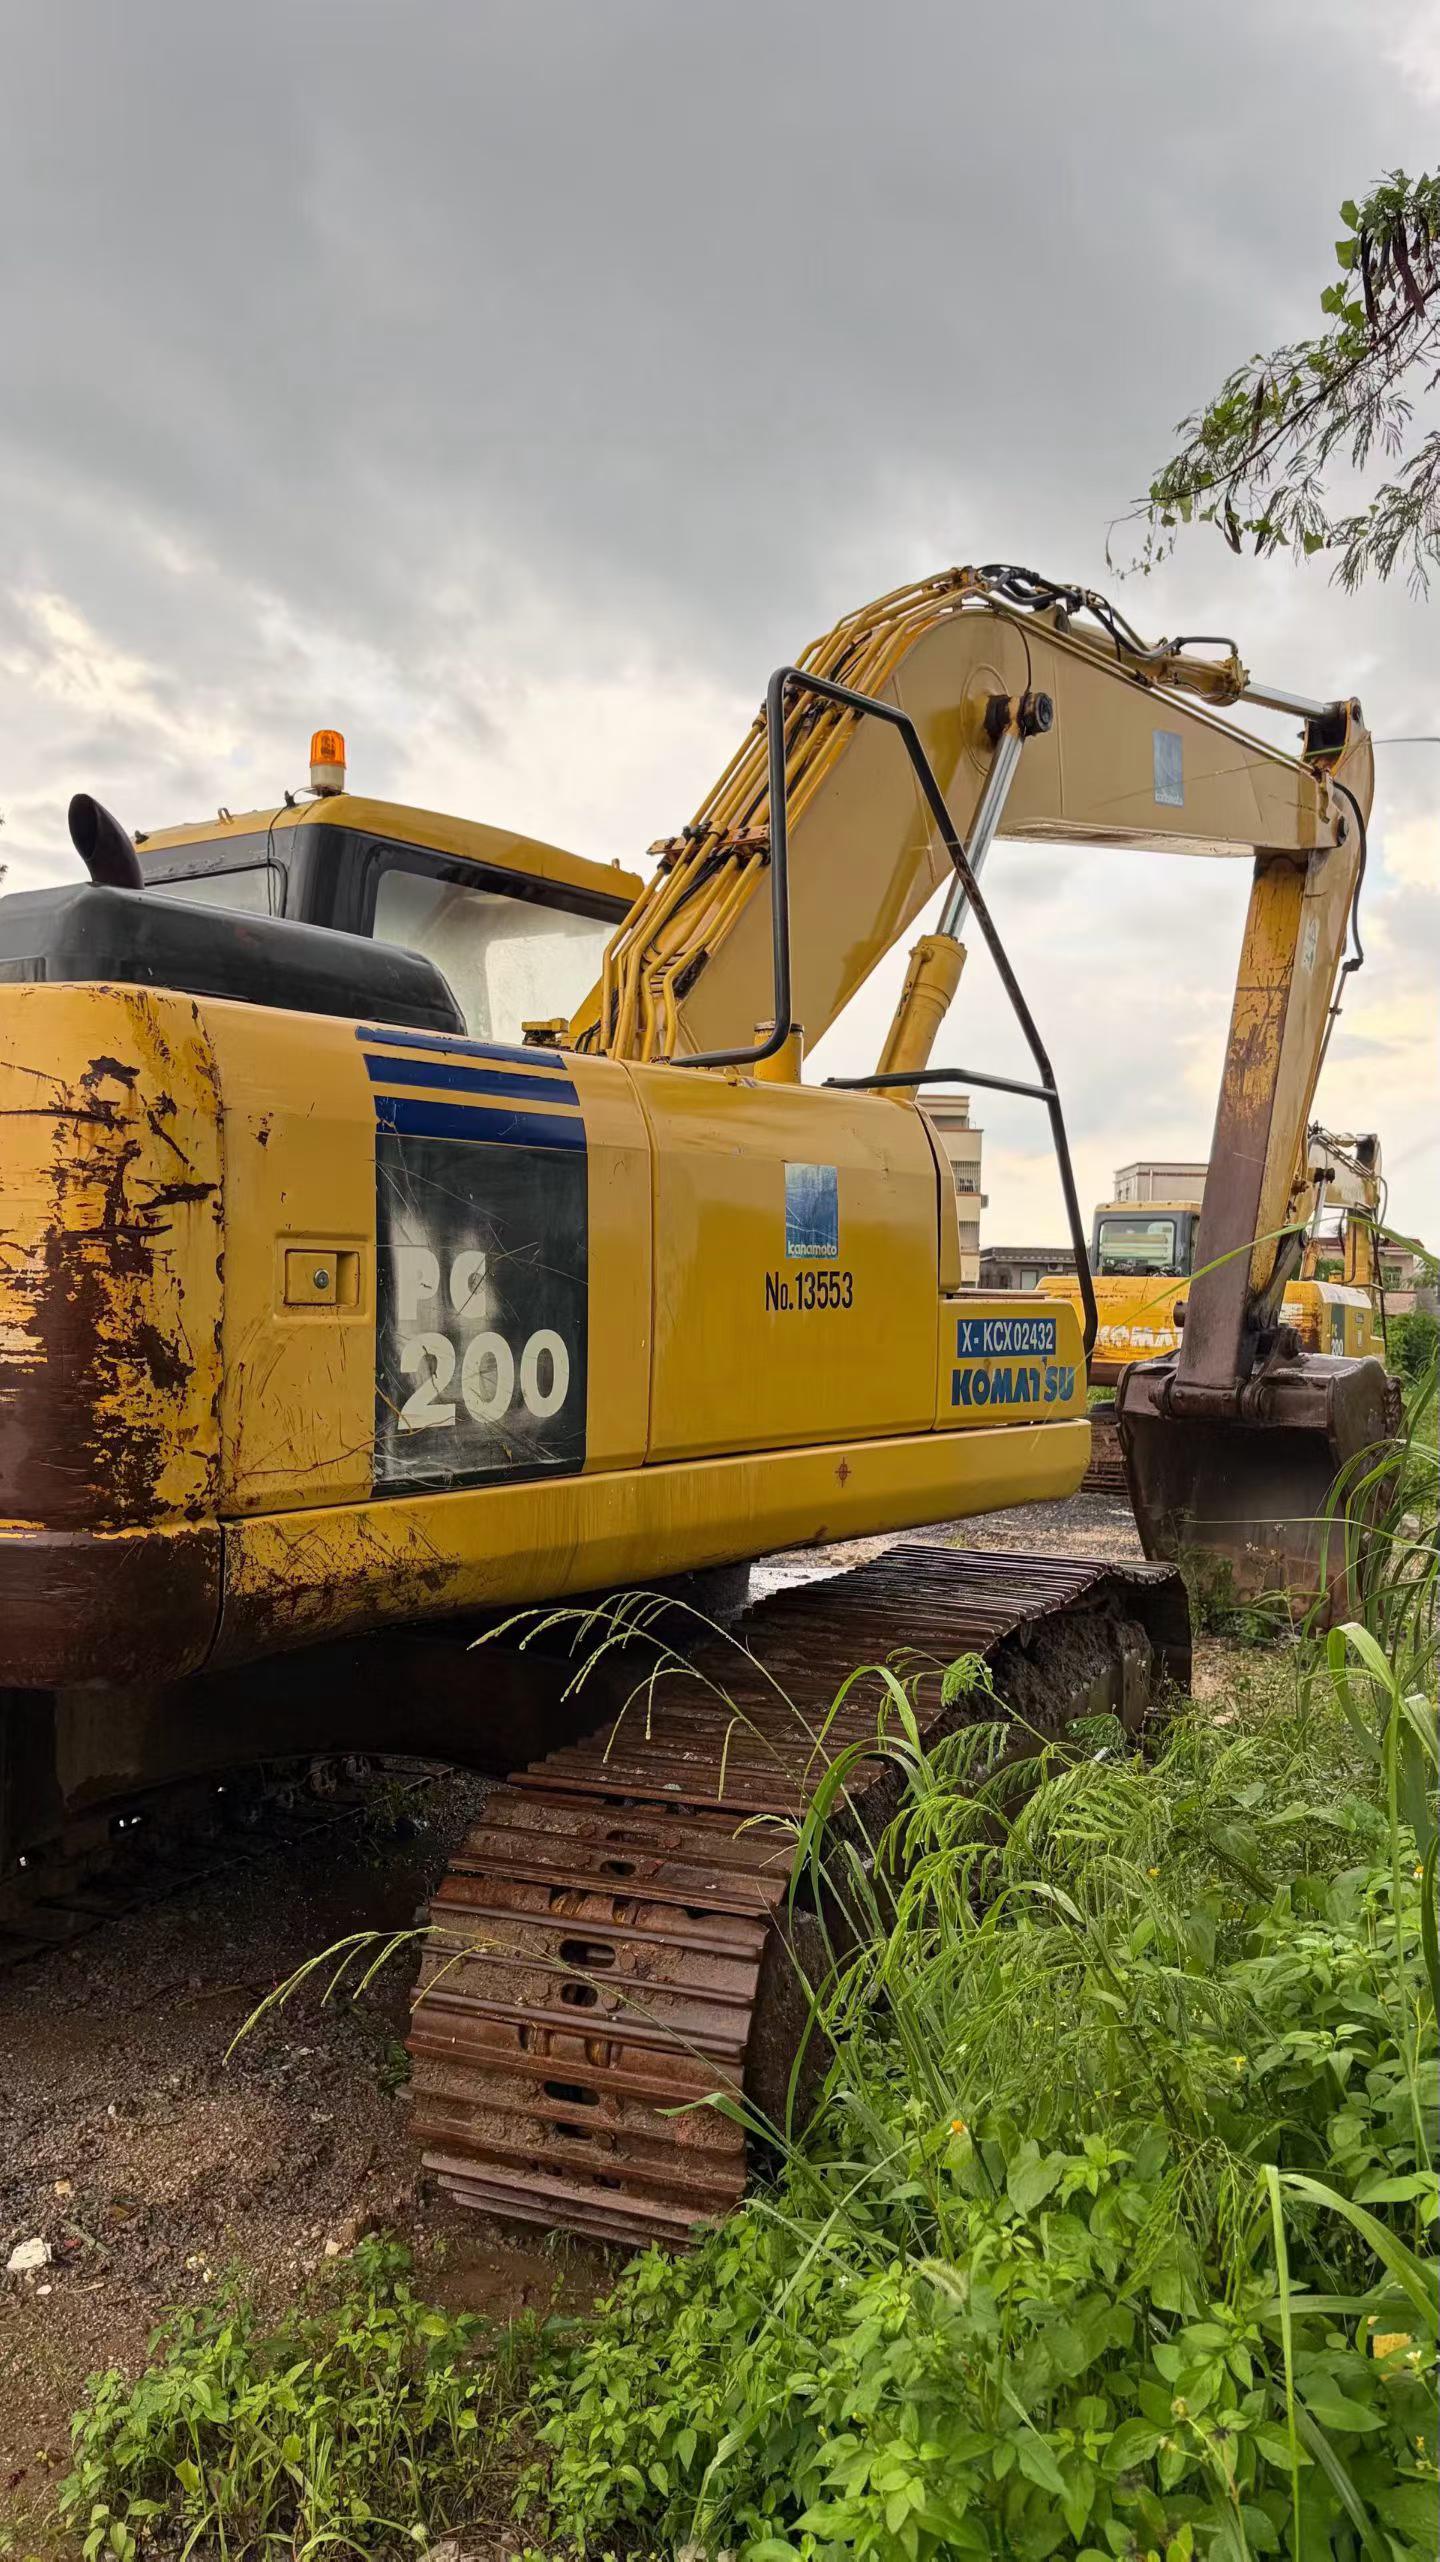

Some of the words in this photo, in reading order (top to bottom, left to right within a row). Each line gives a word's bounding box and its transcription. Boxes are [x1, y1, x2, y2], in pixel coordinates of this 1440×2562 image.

[787, 1241, 837, 1256] kanamoto
[396, 1246, 487, 1320] PC
[765, 1271, 853, 1311] No.13553
[397, 1328, 570, 1430] 200
[951, 1365, 1075, 1406] KOMATSU
